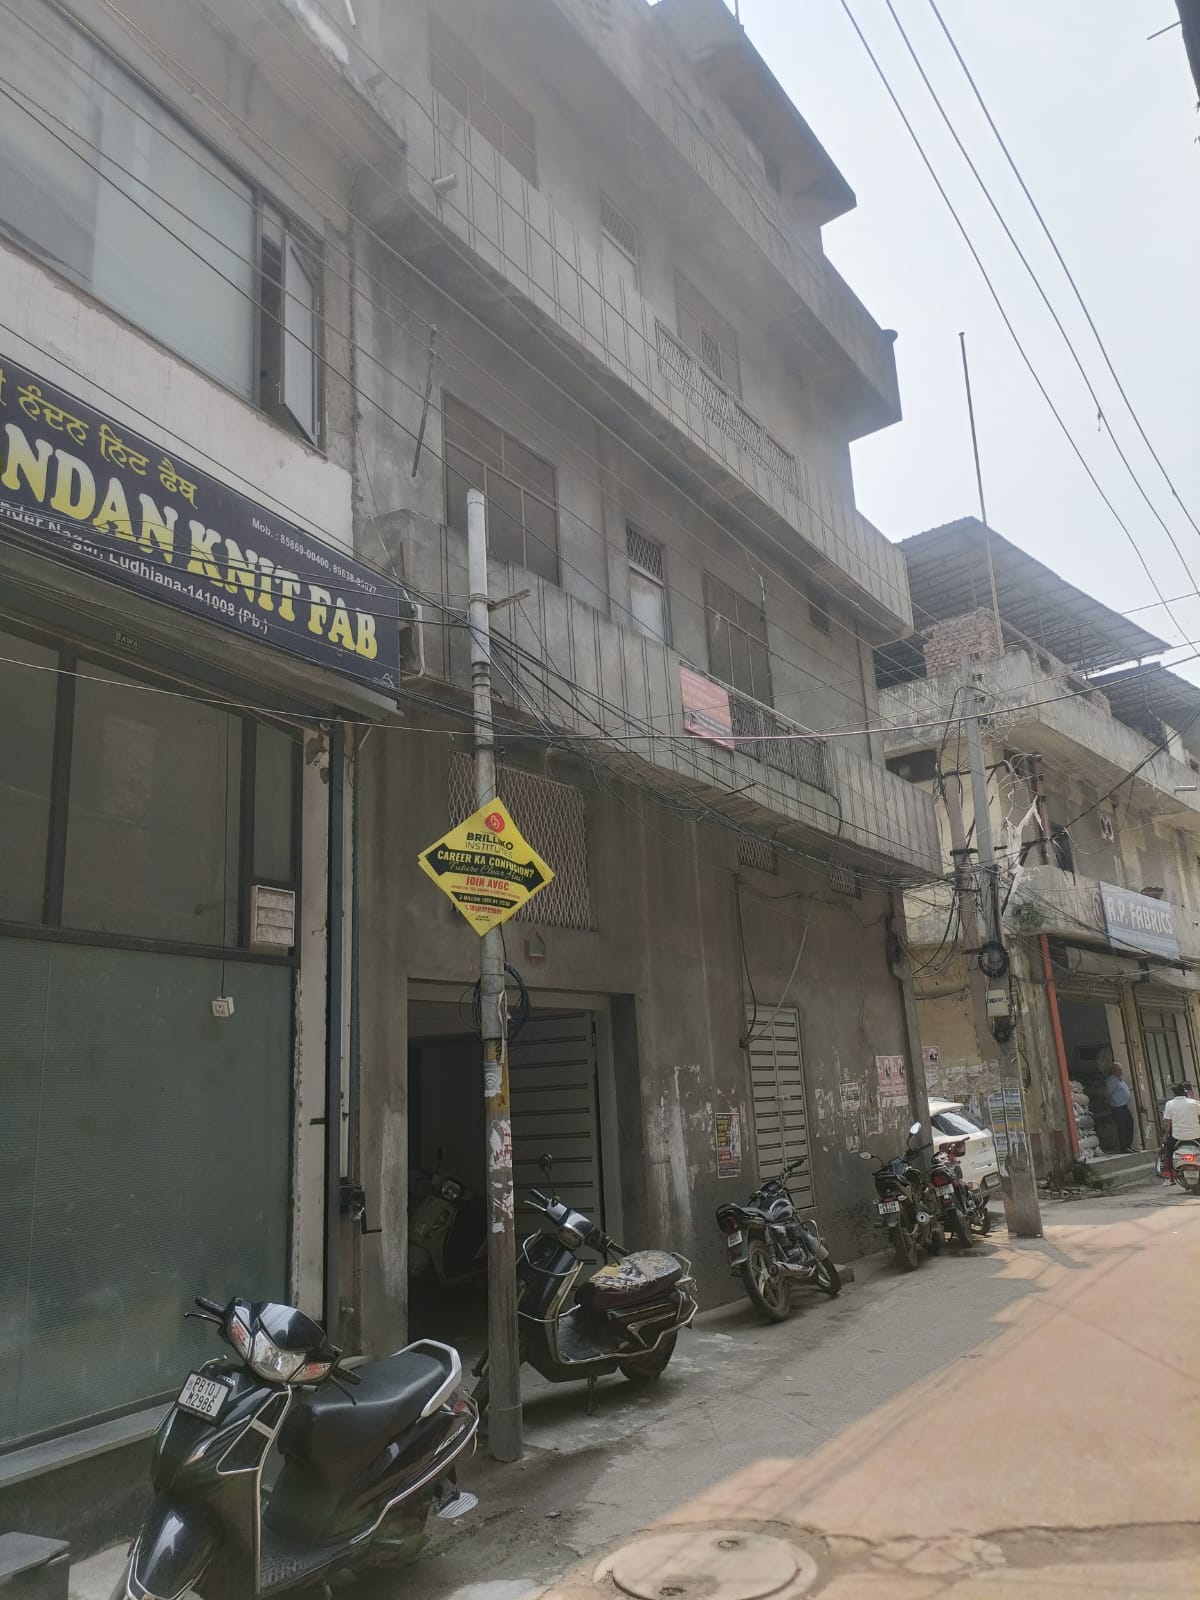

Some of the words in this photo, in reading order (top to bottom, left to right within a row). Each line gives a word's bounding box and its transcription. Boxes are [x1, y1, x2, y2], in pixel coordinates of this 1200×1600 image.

[189, 519, 301, 623] KNIT
[307, 585, 377, 660] FAB
[437, 850, 471, 864] CAREER
[474, 855, 486, 866] KA
[488, 857, 535, 879] CONFUSION?
[465, 875, 485, 888] JOIN
[487, 878, 510, 891] AVGC
[1129, 903, 1173, 935] FABRICS
